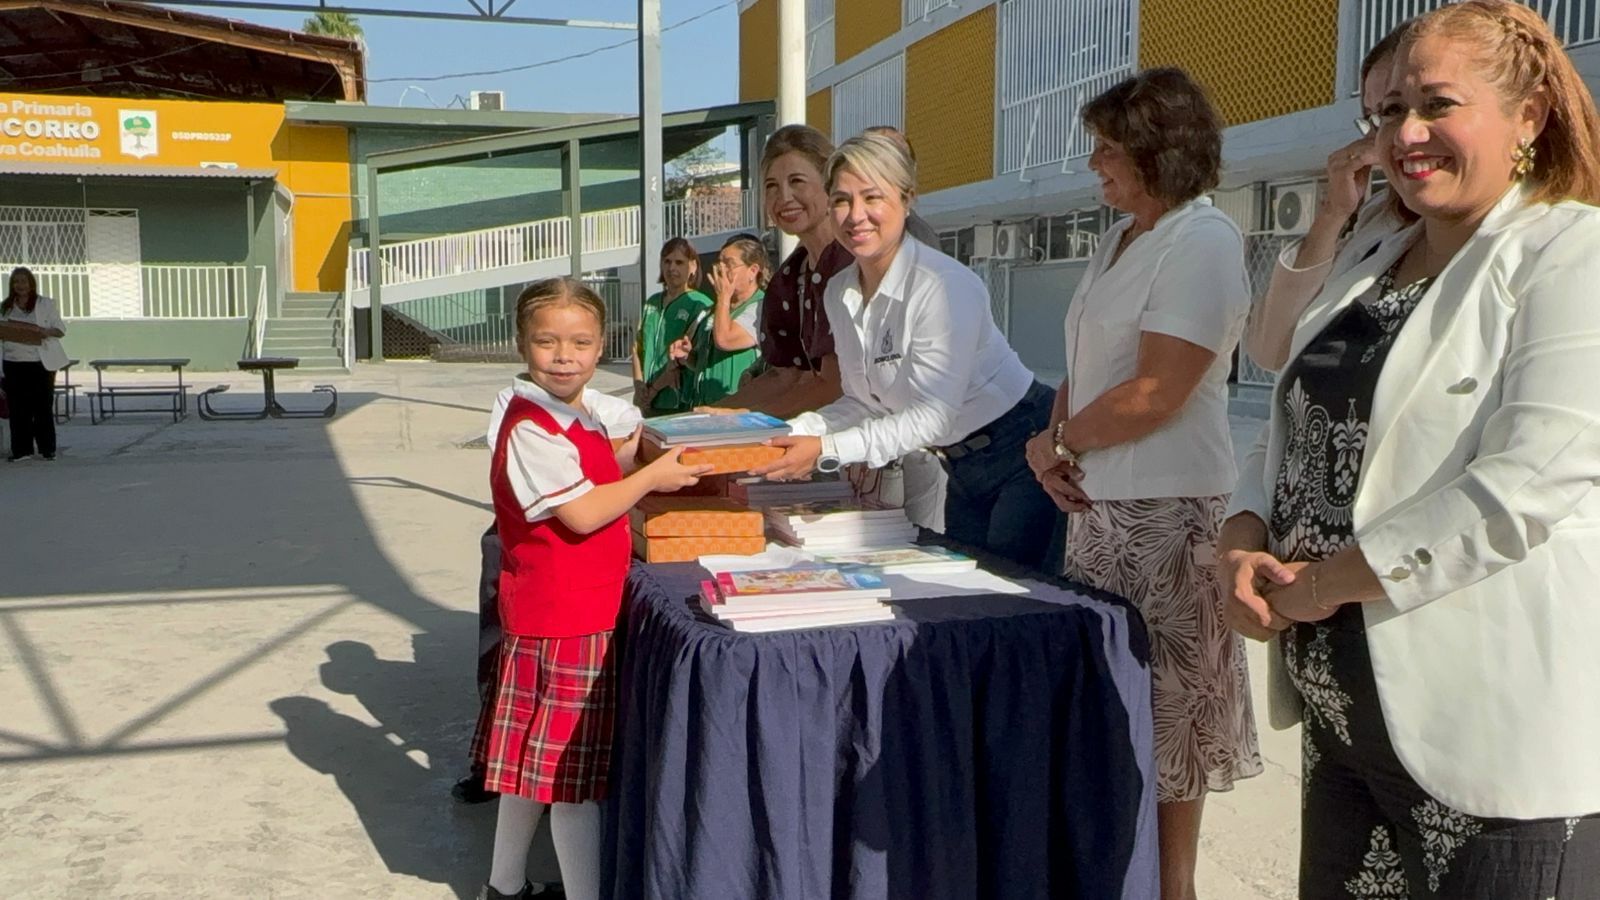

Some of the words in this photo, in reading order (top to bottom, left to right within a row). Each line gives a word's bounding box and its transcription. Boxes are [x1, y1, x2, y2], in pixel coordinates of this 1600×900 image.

[12, 100, 92, 117] Primaria
[0, 118, 99, 140] CORRO
[19, 142, 101, 158] Coahuila
